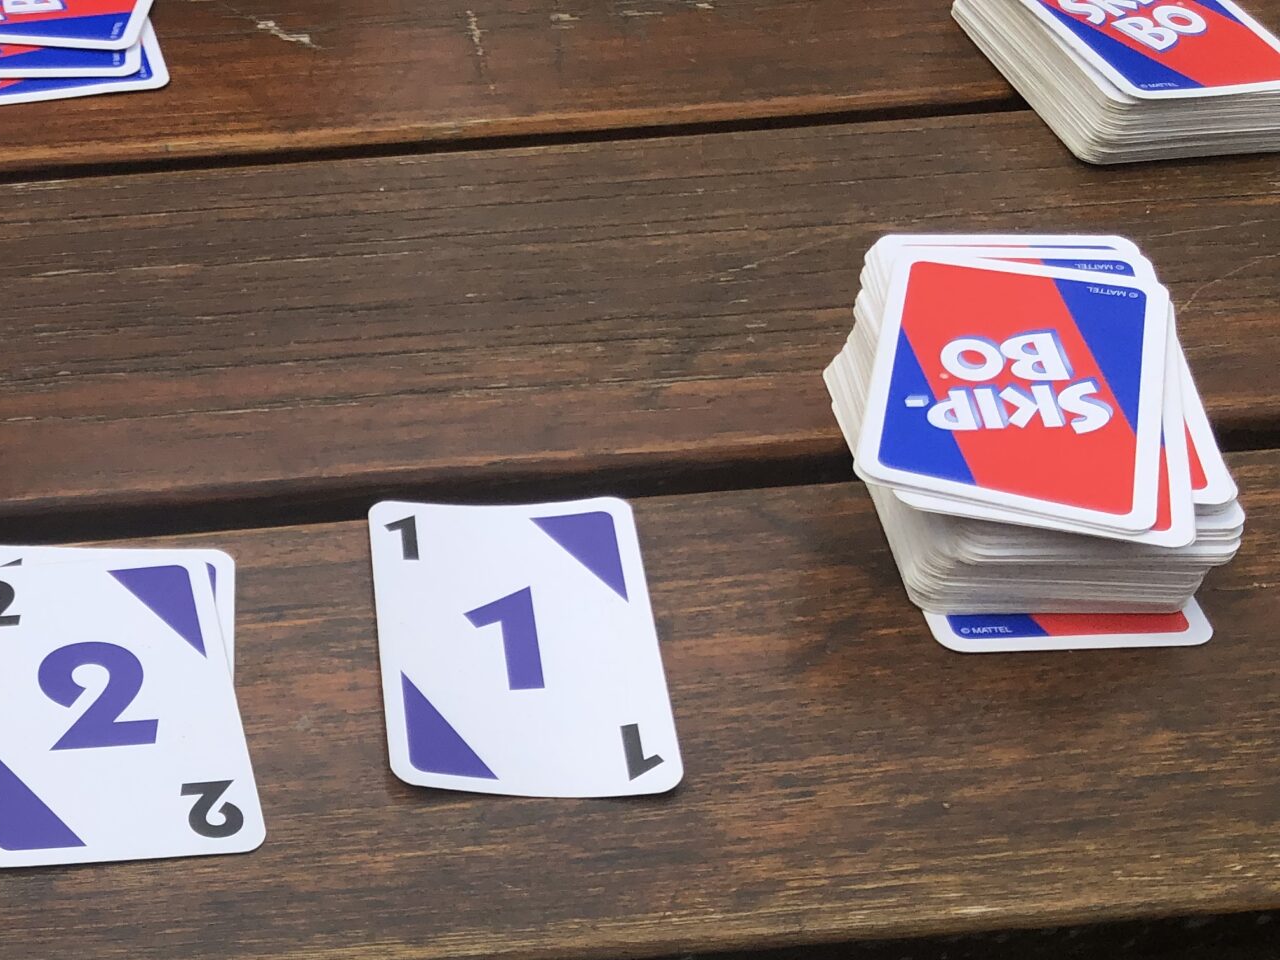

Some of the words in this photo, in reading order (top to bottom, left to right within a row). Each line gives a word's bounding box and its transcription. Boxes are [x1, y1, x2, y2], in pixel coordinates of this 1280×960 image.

[1110, 5, 1208, 53] BO
[1086, 286, 1127, 297] MATTEL
[940, 329, 1075, 382] BO
[385, 515, 419, 560] 1
[464, 586, 545, 690] 1
[972, 626, 1013, 634] MATTEL
[38, 642, 158, 750] 2
[620, 723, 664, 780] 1
[181, 780, 244, 838] 2
